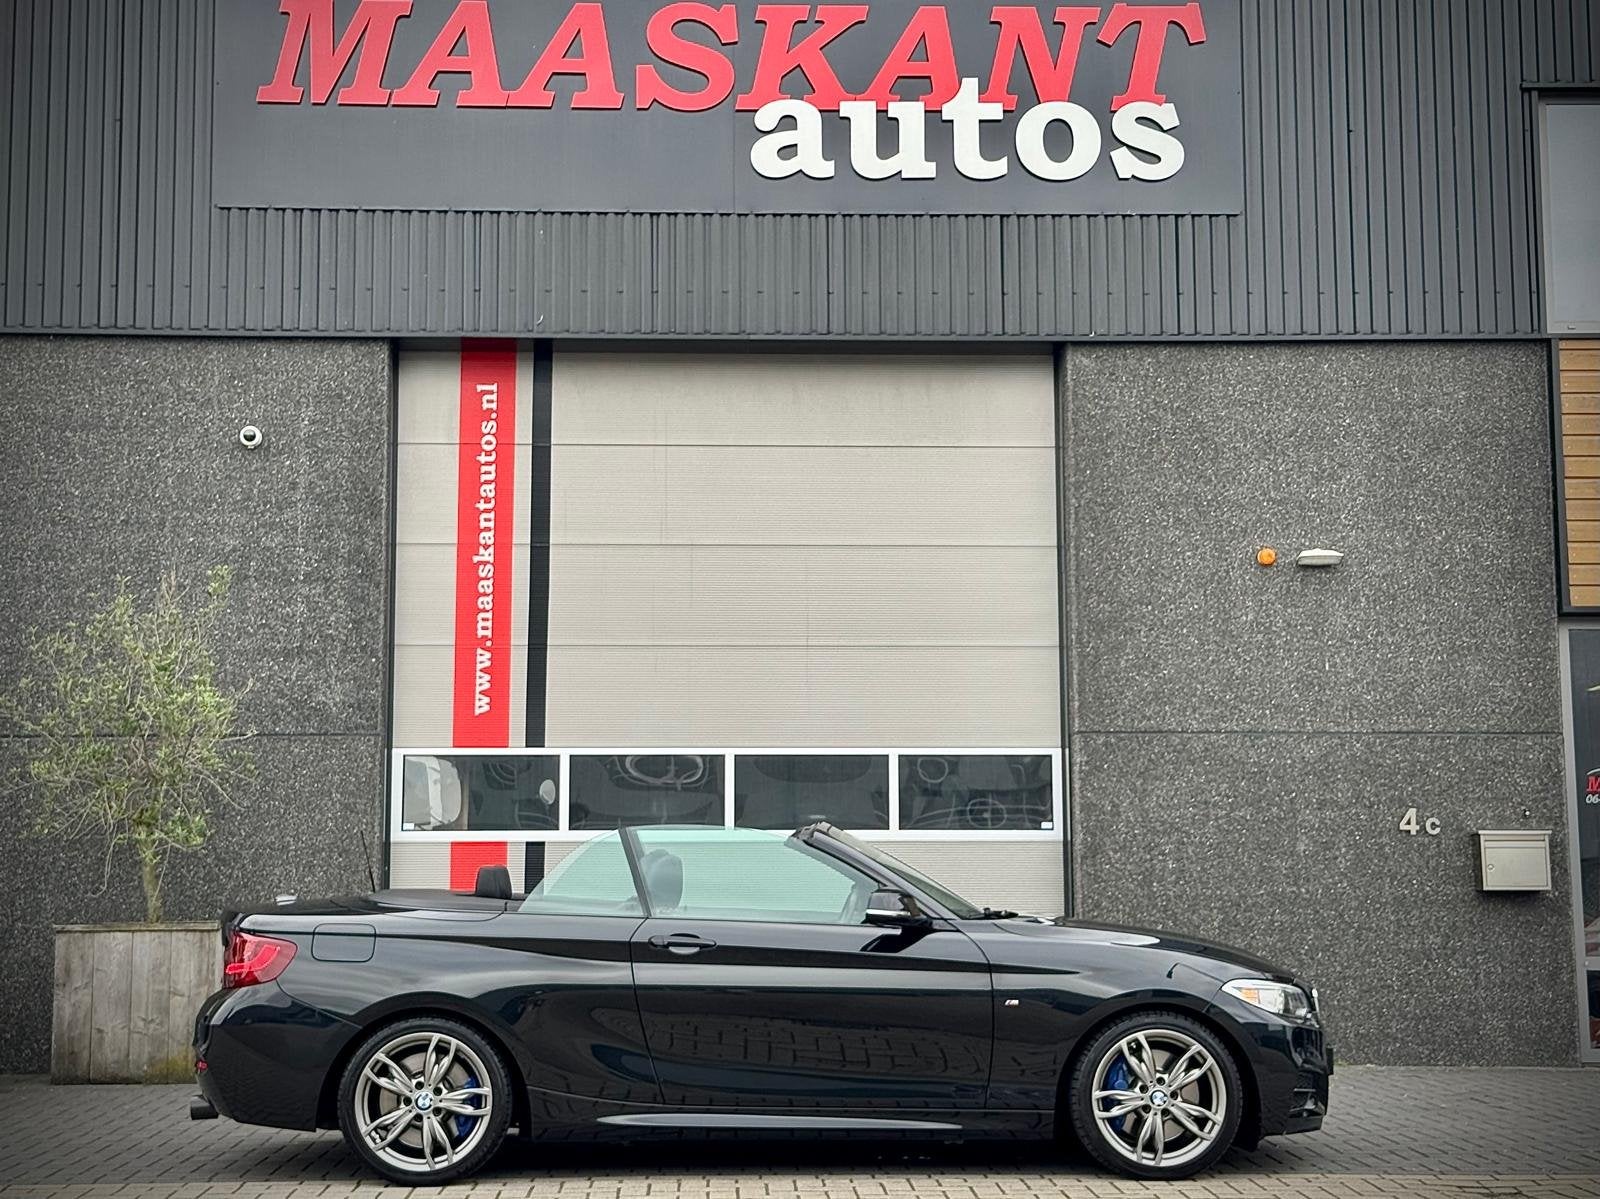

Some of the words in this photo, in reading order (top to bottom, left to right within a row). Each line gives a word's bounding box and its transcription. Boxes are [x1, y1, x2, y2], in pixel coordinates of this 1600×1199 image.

[256, 0, 1207, 111] MAASKANT
[750, 77, 1185, 181] autos
[473, 382, 498, 716] www.maaskantautos.nl
